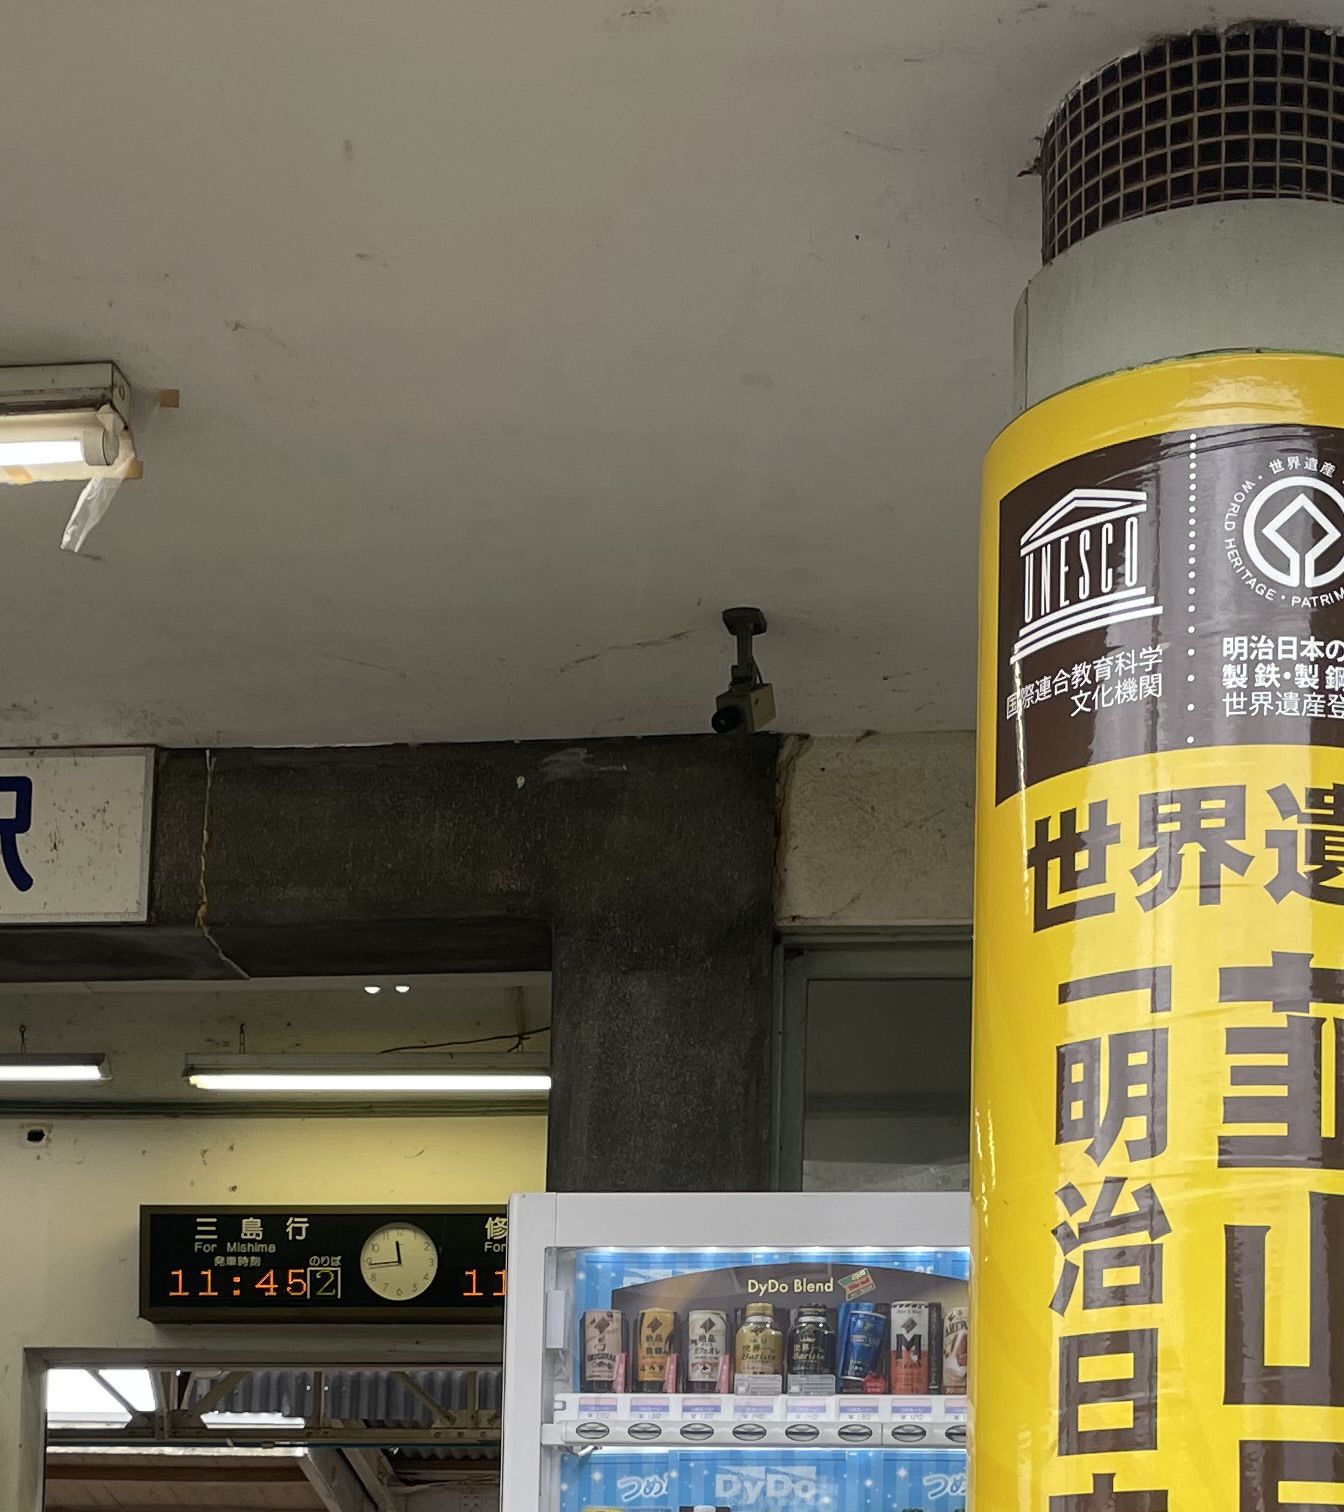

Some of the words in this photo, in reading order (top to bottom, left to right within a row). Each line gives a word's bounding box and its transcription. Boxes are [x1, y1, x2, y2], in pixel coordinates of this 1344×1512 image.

[1267, 455, 1337, 479] 世界遺産
[1222, 479, 1254, 532] WORLD
[1022, 516, 1141, 624] UNESCO
[1224, 536, 1278, 604] HERITAGE
[1005, 646, 1164, 721] 国際連合教育科学
[1069, 674, 1163, 718] 文化機関
[195, 1216, 309, 1241] 三島行
[194, 1242, 217, 1253] For
[226, 1242, 277, 1253] Mishima
[309, 1256, 342, 1267] のりば
[168, 1268, 308, 1297] 11:45
[315, 1269, 337, 1297] 2
[747, 1278, 789, 1297] DyDo
[793, 1277, 834, 1293] Blend
[715, 1473, 817, 1505] DyDo
